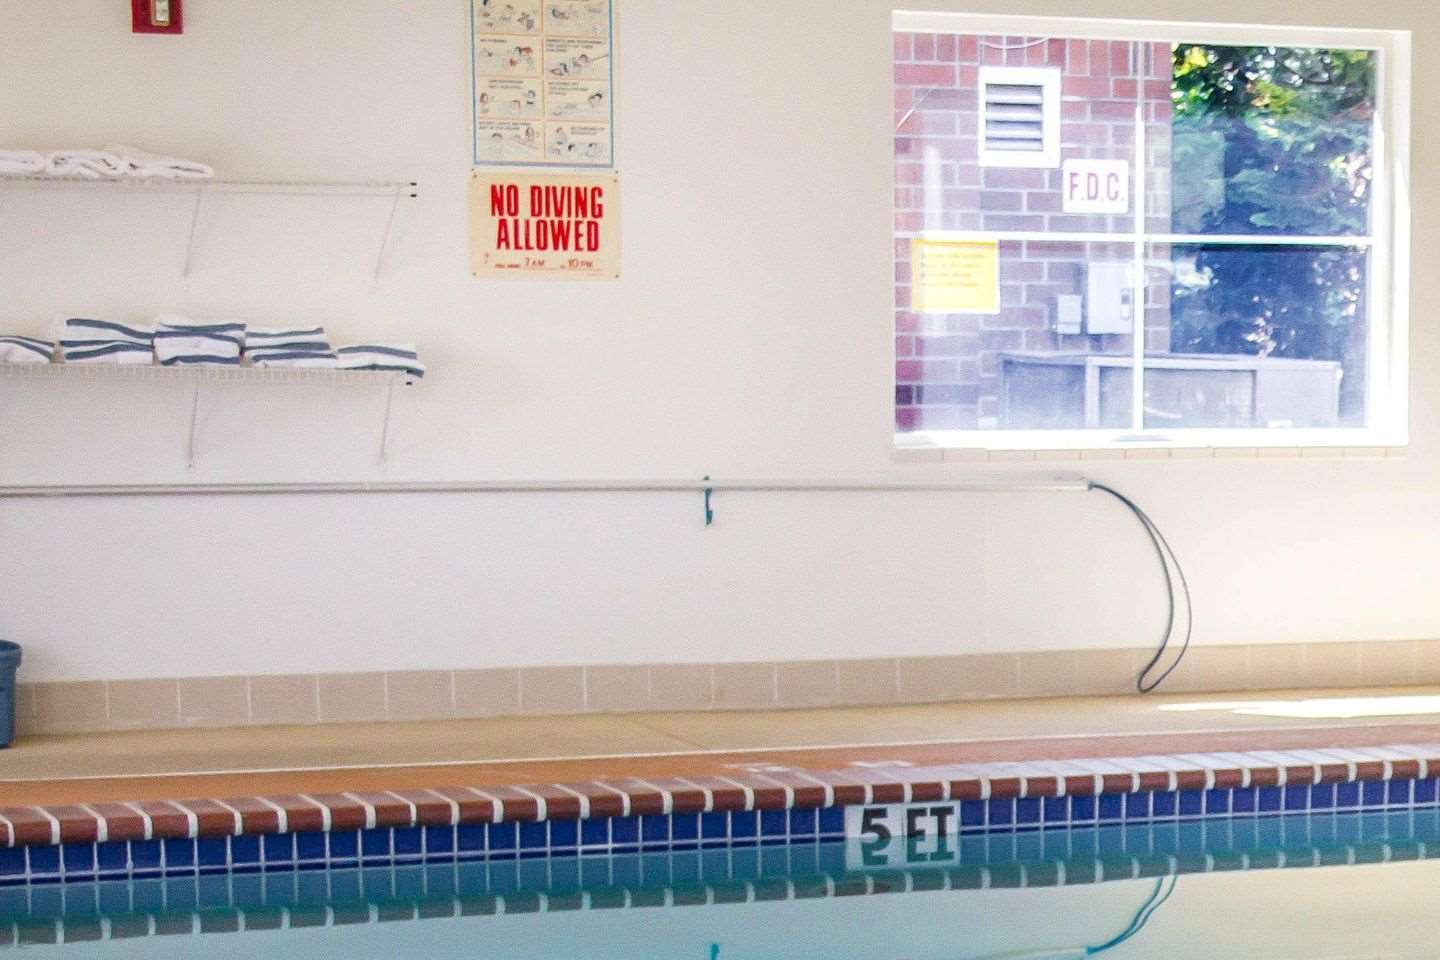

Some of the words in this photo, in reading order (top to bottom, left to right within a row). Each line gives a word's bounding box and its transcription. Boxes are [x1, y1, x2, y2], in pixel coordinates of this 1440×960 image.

[491, 184, 519, 217] NO
[530, 185, 604, 219] DIVING
[497, 219, 600, 252] ALLOWED
[861, 807, 892, 839] 5
